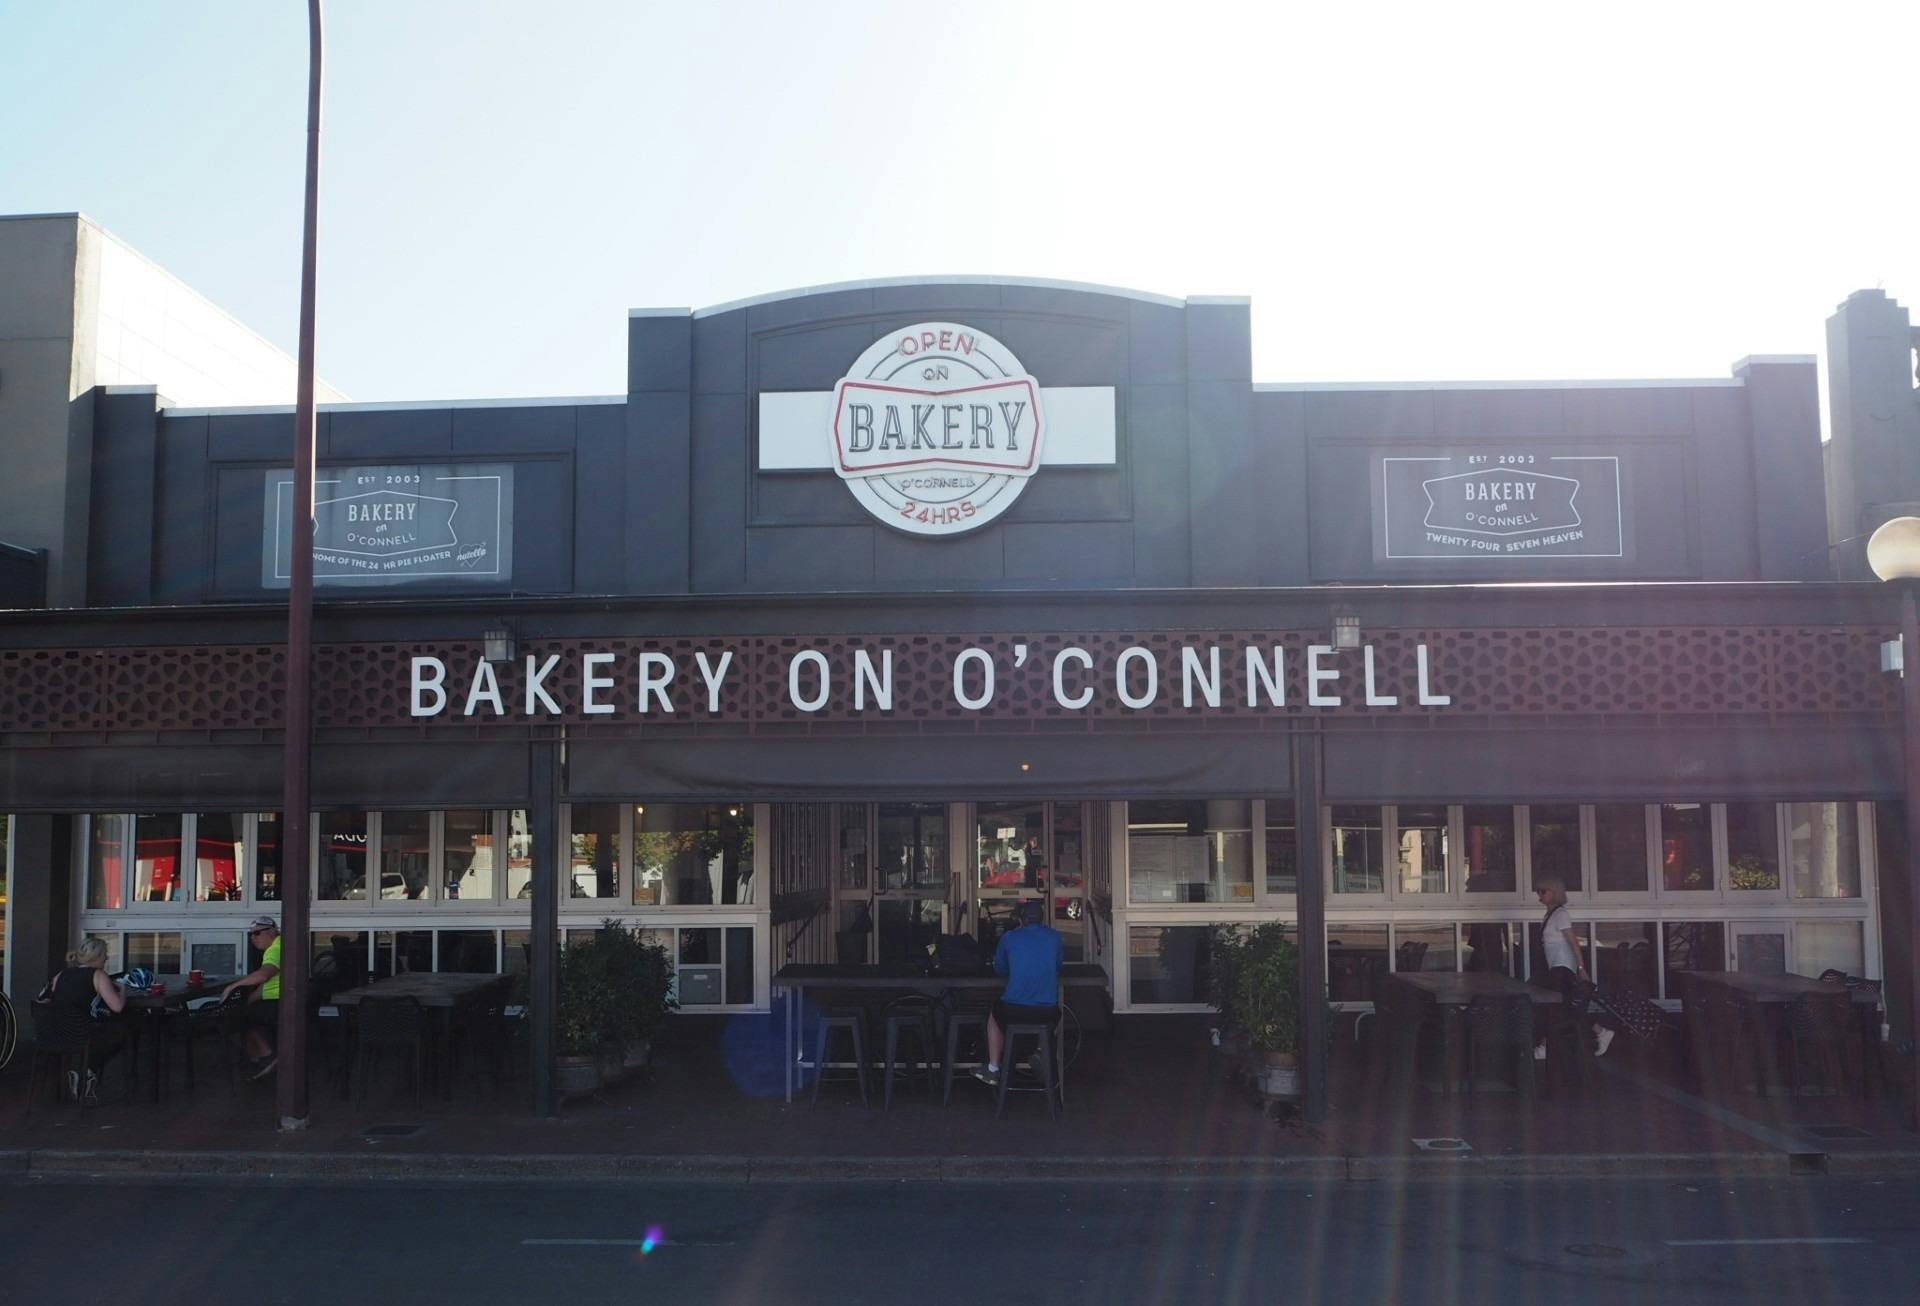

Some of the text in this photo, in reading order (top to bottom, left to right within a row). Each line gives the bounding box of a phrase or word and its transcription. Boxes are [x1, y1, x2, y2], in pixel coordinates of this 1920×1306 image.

[900, 331, 974, 355] OPEN
[923, 366, 949, 381] ON
[849, 401, 1026, 452] BAKERY
[1499, 456, 1535, 464] 2003
[386, 475, 420, 484] 2003
[900, 478, 976, 491] O'CONNELL
[1465, 482, 1536, 500] BAKERY
[348, 503, 416, 522] BAKERY
[901, 501, 977, 525] 24HRS
[1495, 503, 1508, 513] on
[1465, 512, 1539, 526] O'CONNELL
[347, 532, 416, 547] O'CONNELL
[1425, 530, 1584, 552] TWENTY FOUR SEVEN HEAVEN
[312, 551, 451, 570] HOME OF THE 24 HR PIE FLOATER
[411, 644, 1451, 717] BAKERY ON O'CONNELL
